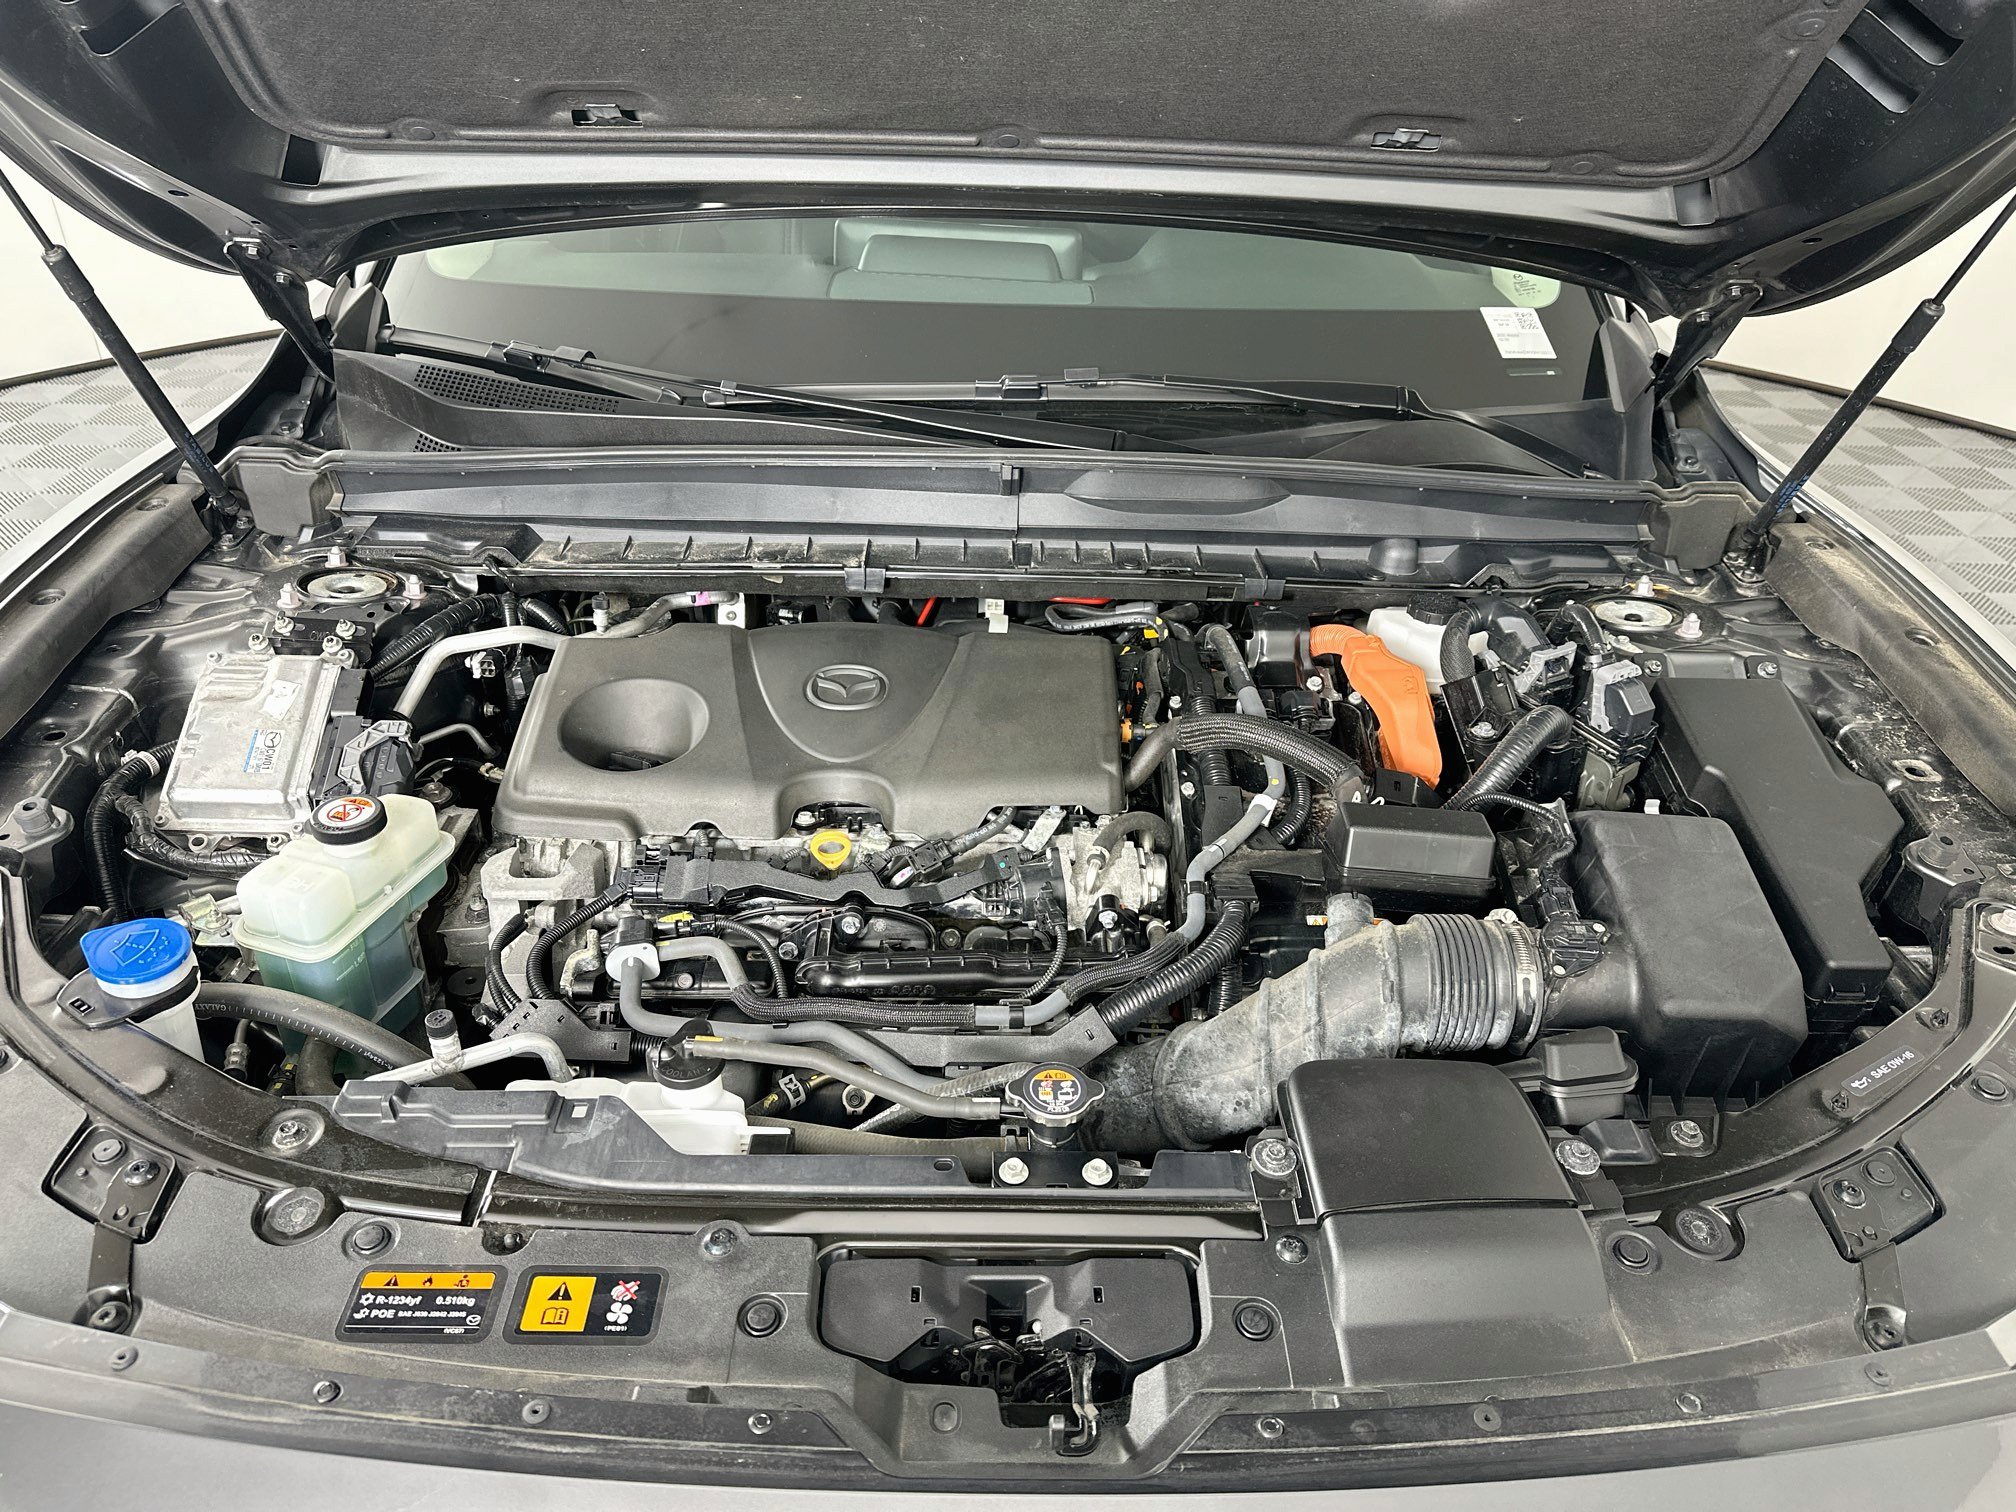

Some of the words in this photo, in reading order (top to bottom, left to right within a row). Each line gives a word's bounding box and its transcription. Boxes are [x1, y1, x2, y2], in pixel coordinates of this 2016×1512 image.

[261, 748, 276, 770] CW01
[194, 1003, 227, 1011] GALAXY
[1870, 1064, 1892, 1079] SAE
[1886, 1050, 1915, 1069] 0W-16
[661, 1065, 708, 1079] COOLANT
[375, 1295, 423, 1307] R-1234yf
[435, 1296, 476, 1307] 0.510kg
[370, 1309, 396, 1319] POE
